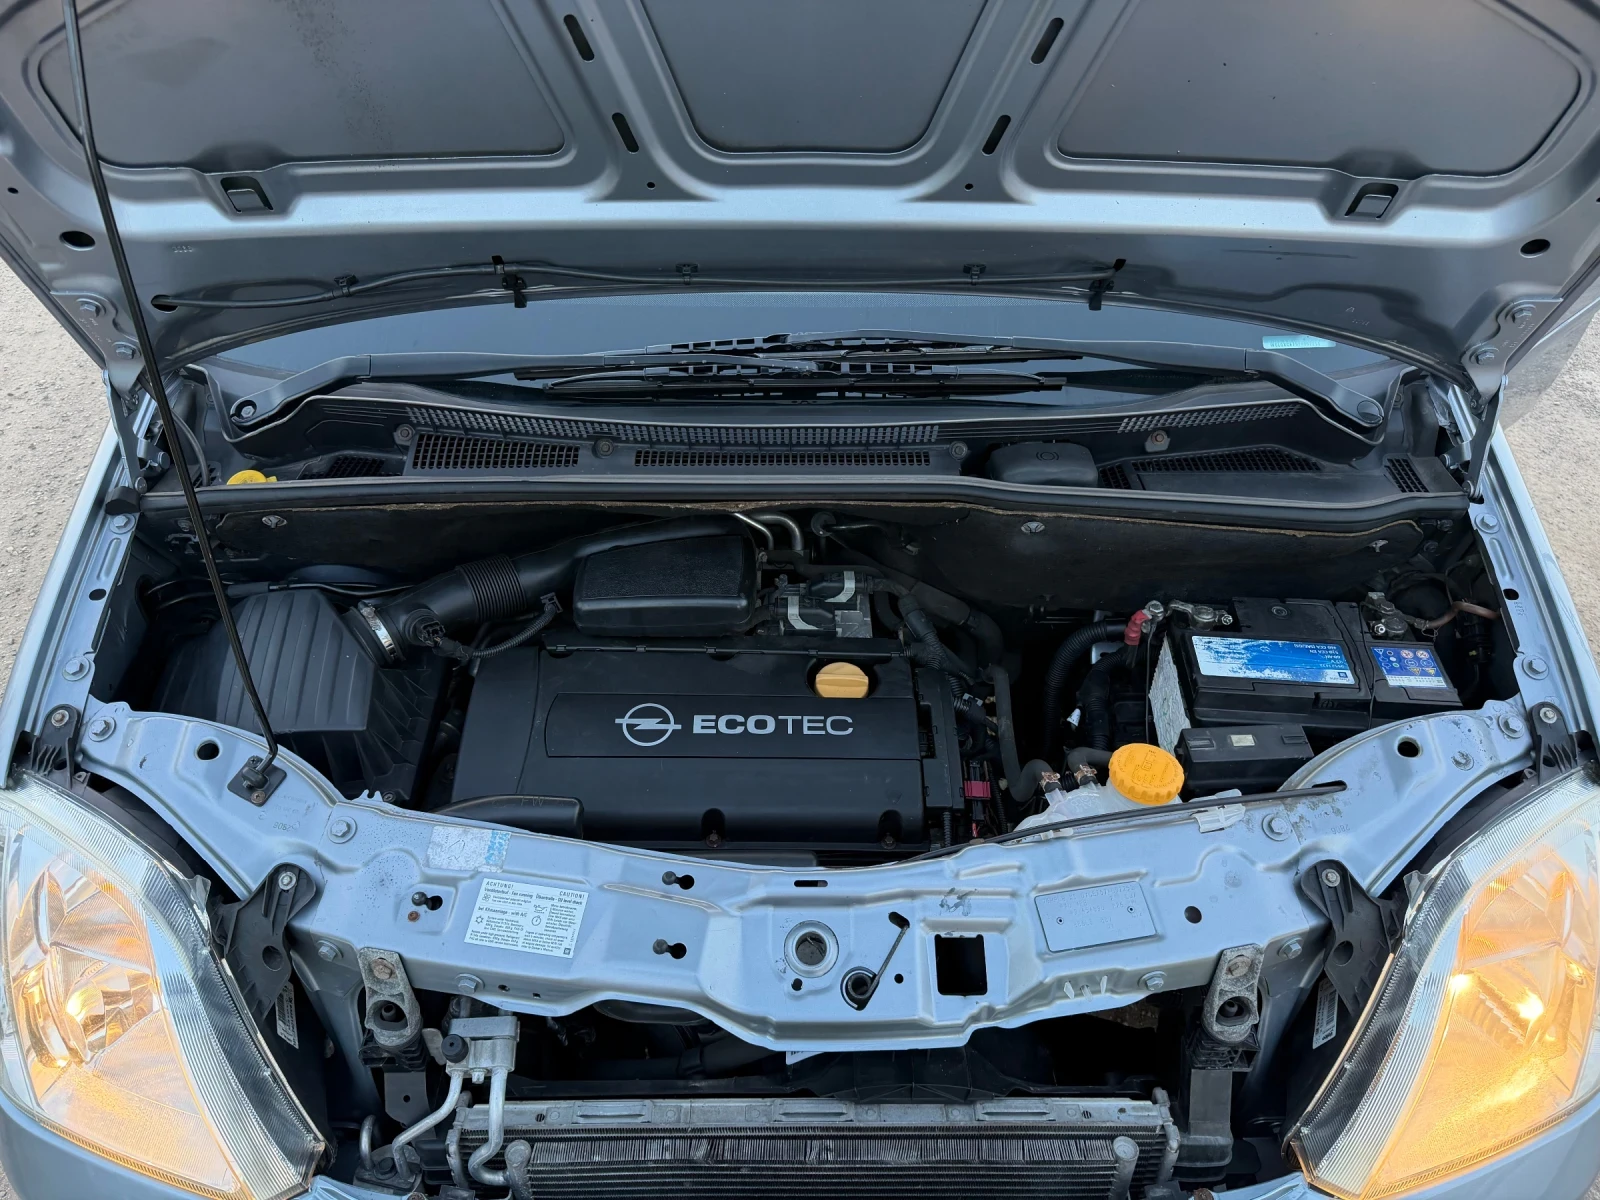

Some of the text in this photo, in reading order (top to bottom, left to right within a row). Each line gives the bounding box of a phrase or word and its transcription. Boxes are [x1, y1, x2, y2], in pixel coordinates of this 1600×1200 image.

[693, 714, 854, 736] ECOTEC
[485, 880, 514, 889] ACHTUNG!
[559, 890, 585, 899] CAUTION!
